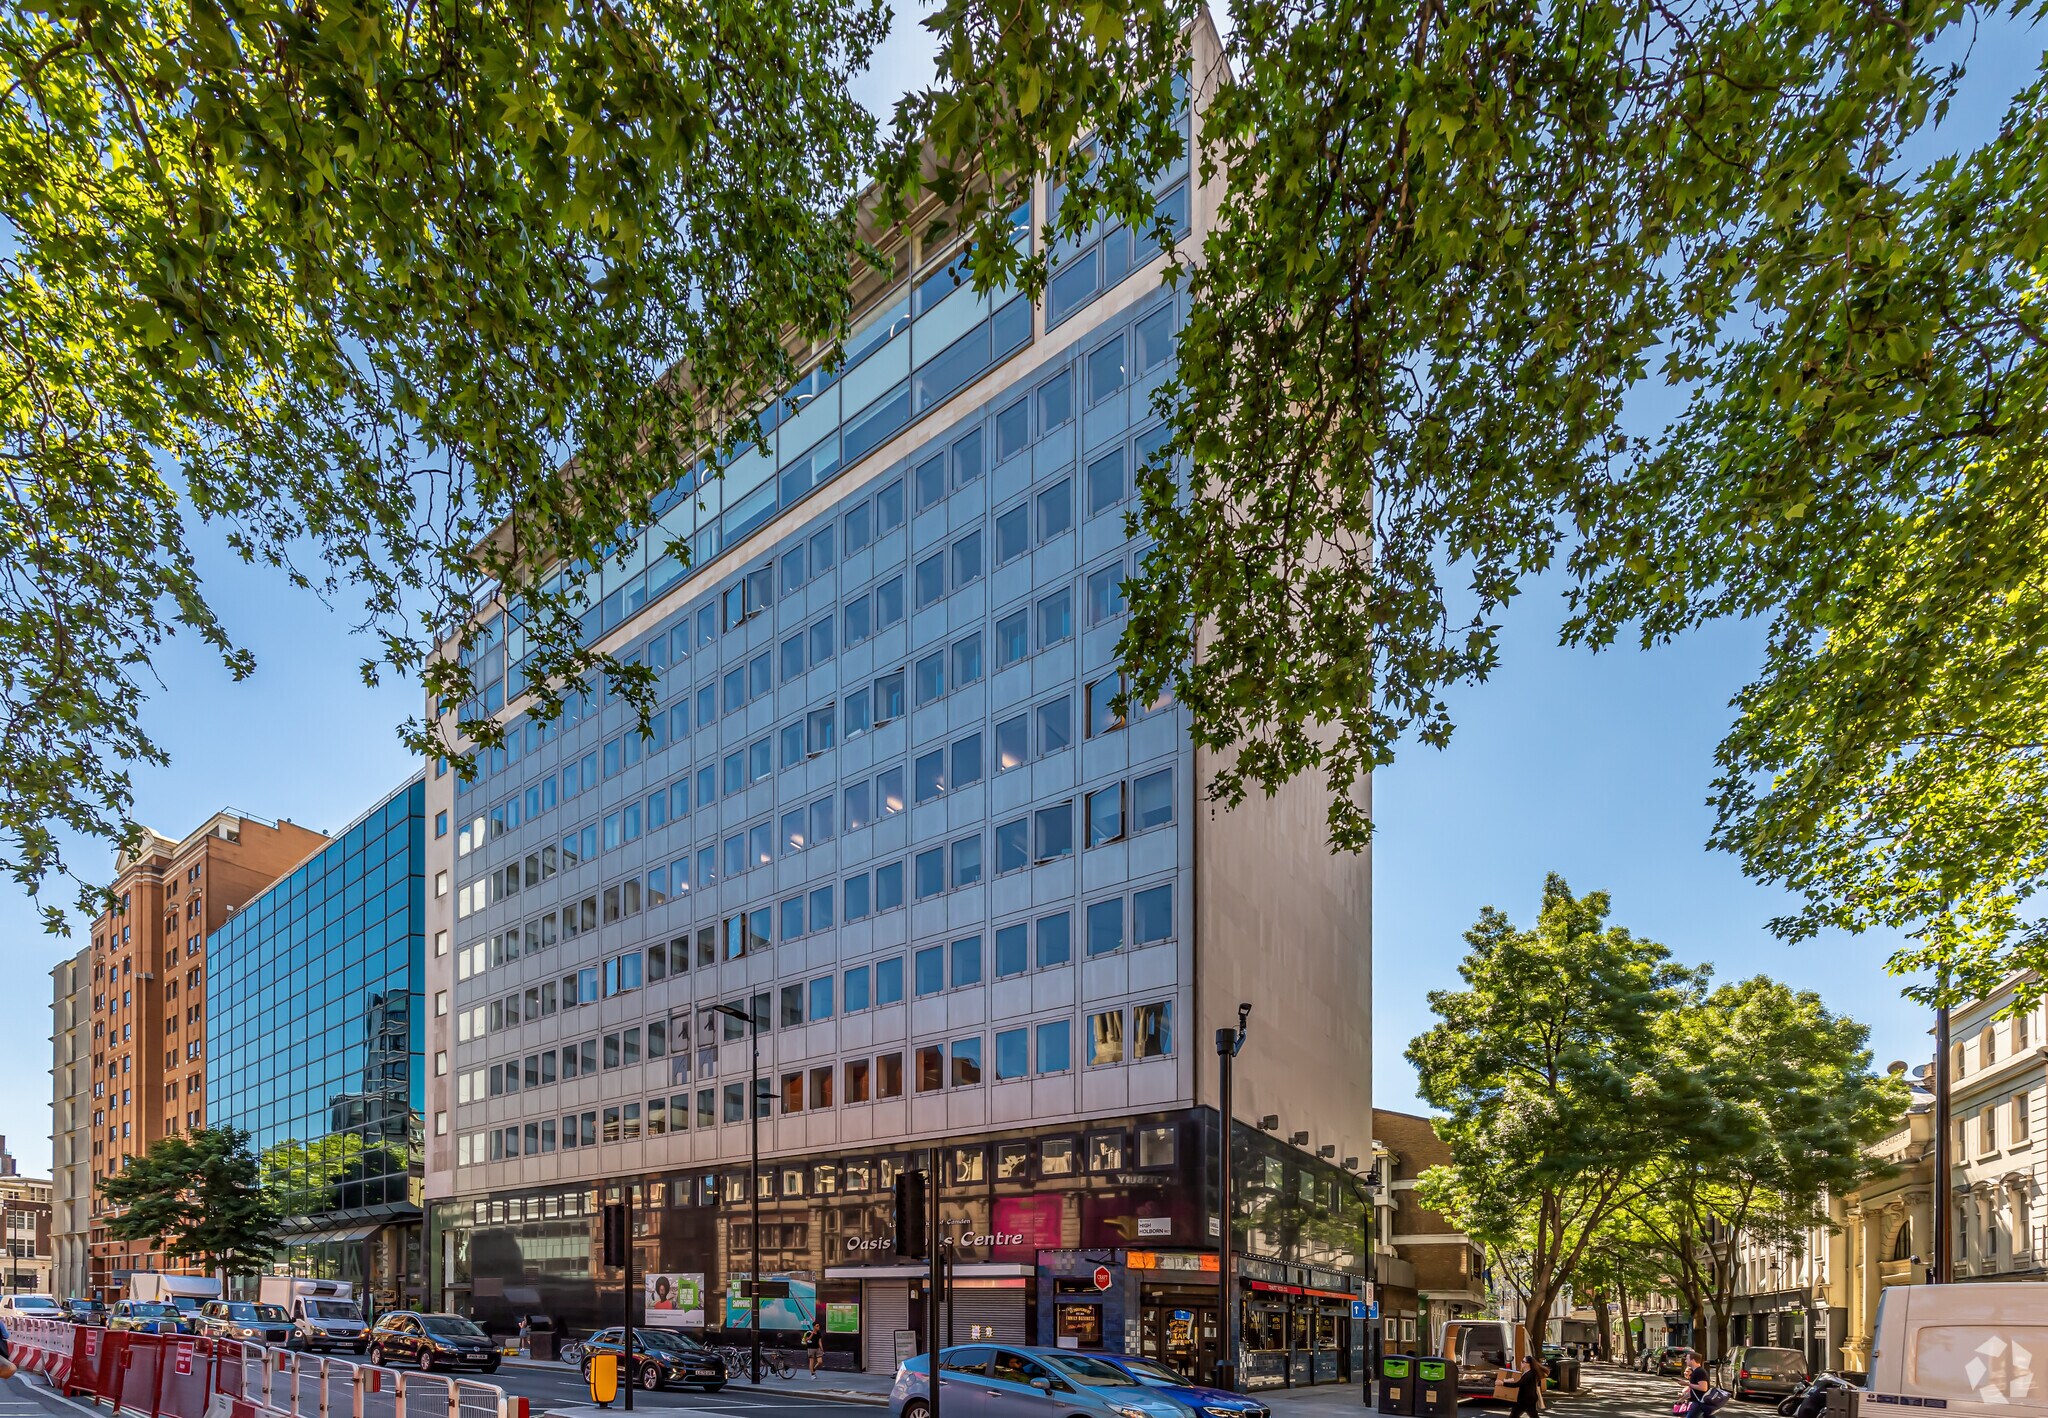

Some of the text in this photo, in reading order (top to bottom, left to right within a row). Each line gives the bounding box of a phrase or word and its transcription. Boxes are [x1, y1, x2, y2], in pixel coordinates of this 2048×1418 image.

[847, 1236, 891, 1250] Oasis
[960, 1231, 1023, 1247] Centre
[1173, 1332, 1188, 1340] TAP
